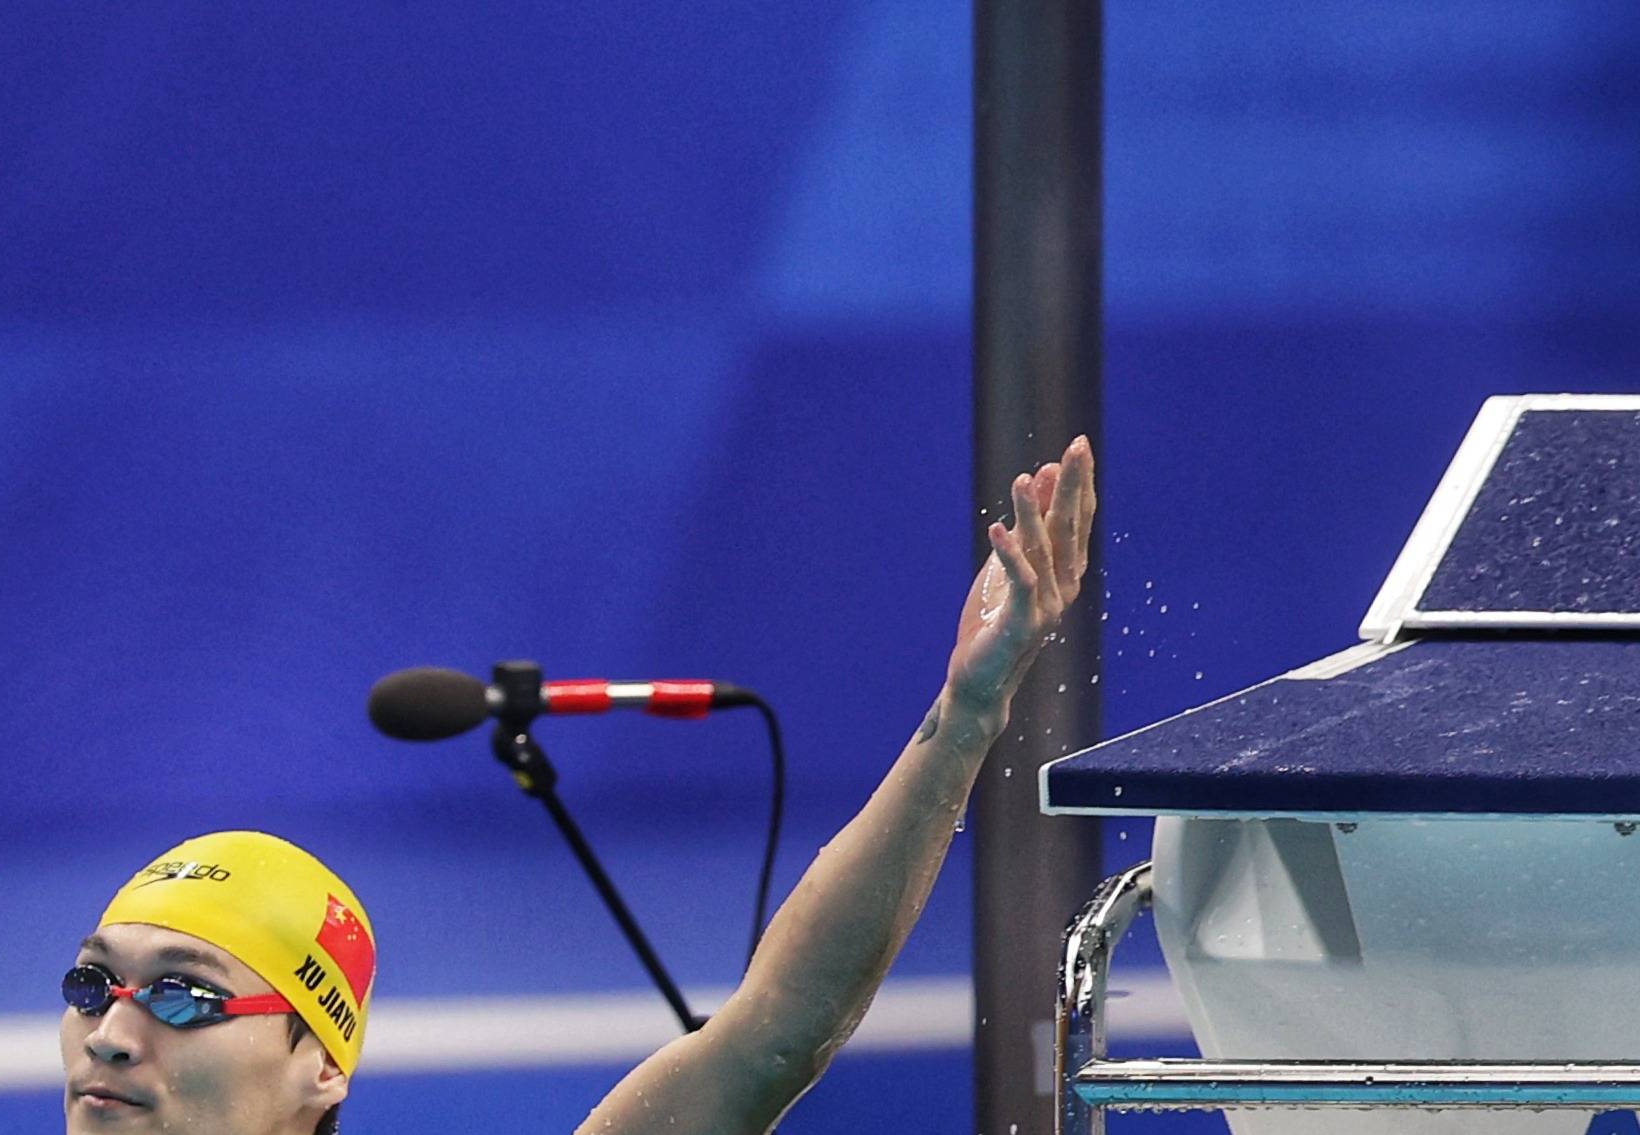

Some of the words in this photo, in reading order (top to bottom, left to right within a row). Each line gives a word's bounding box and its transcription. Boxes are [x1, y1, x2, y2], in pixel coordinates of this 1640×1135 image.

[141, 861, 231, 882] spedo
[294, 953, 327, 992] XU
[317, 985, 357, 1043] JIAYU
